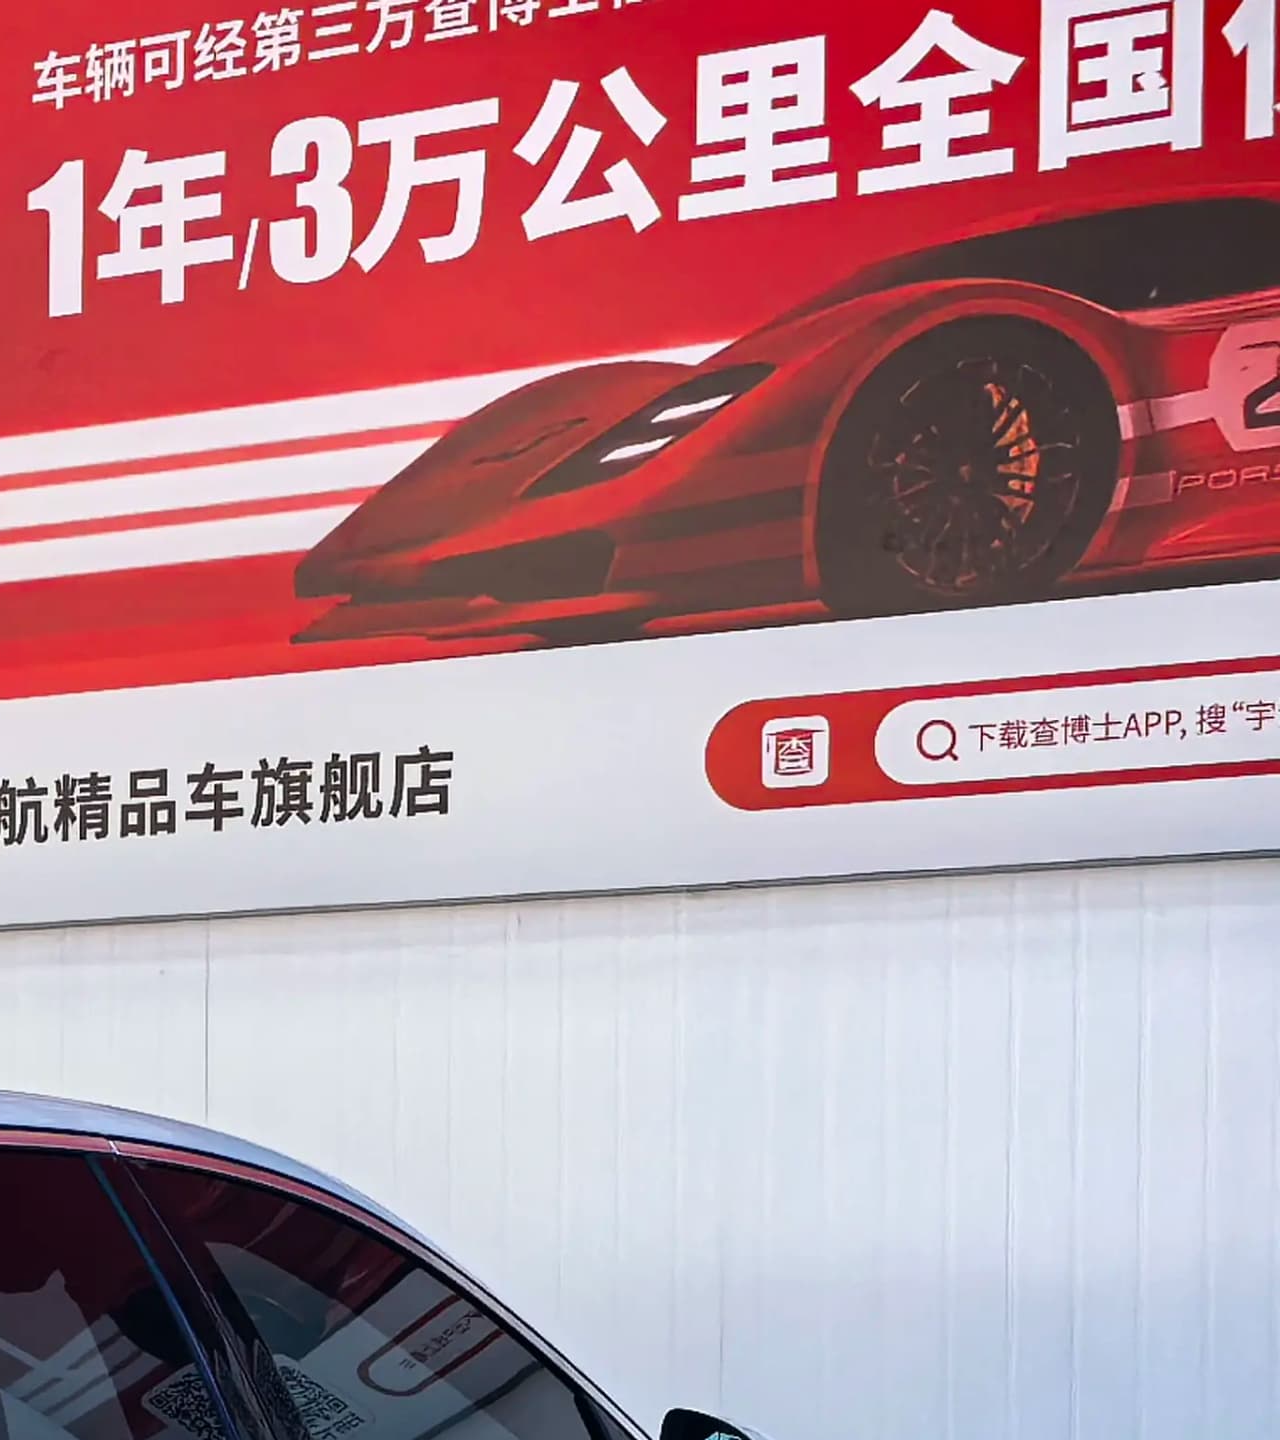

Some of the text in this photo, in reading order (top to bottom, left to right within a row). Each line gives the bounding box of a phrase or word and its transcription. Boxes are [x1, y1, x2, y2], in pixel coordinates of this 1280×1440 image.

[32, 0, 652, 109] 车辆可经第三方查博
[1196, 699, 1280, 736] 搜“宇
